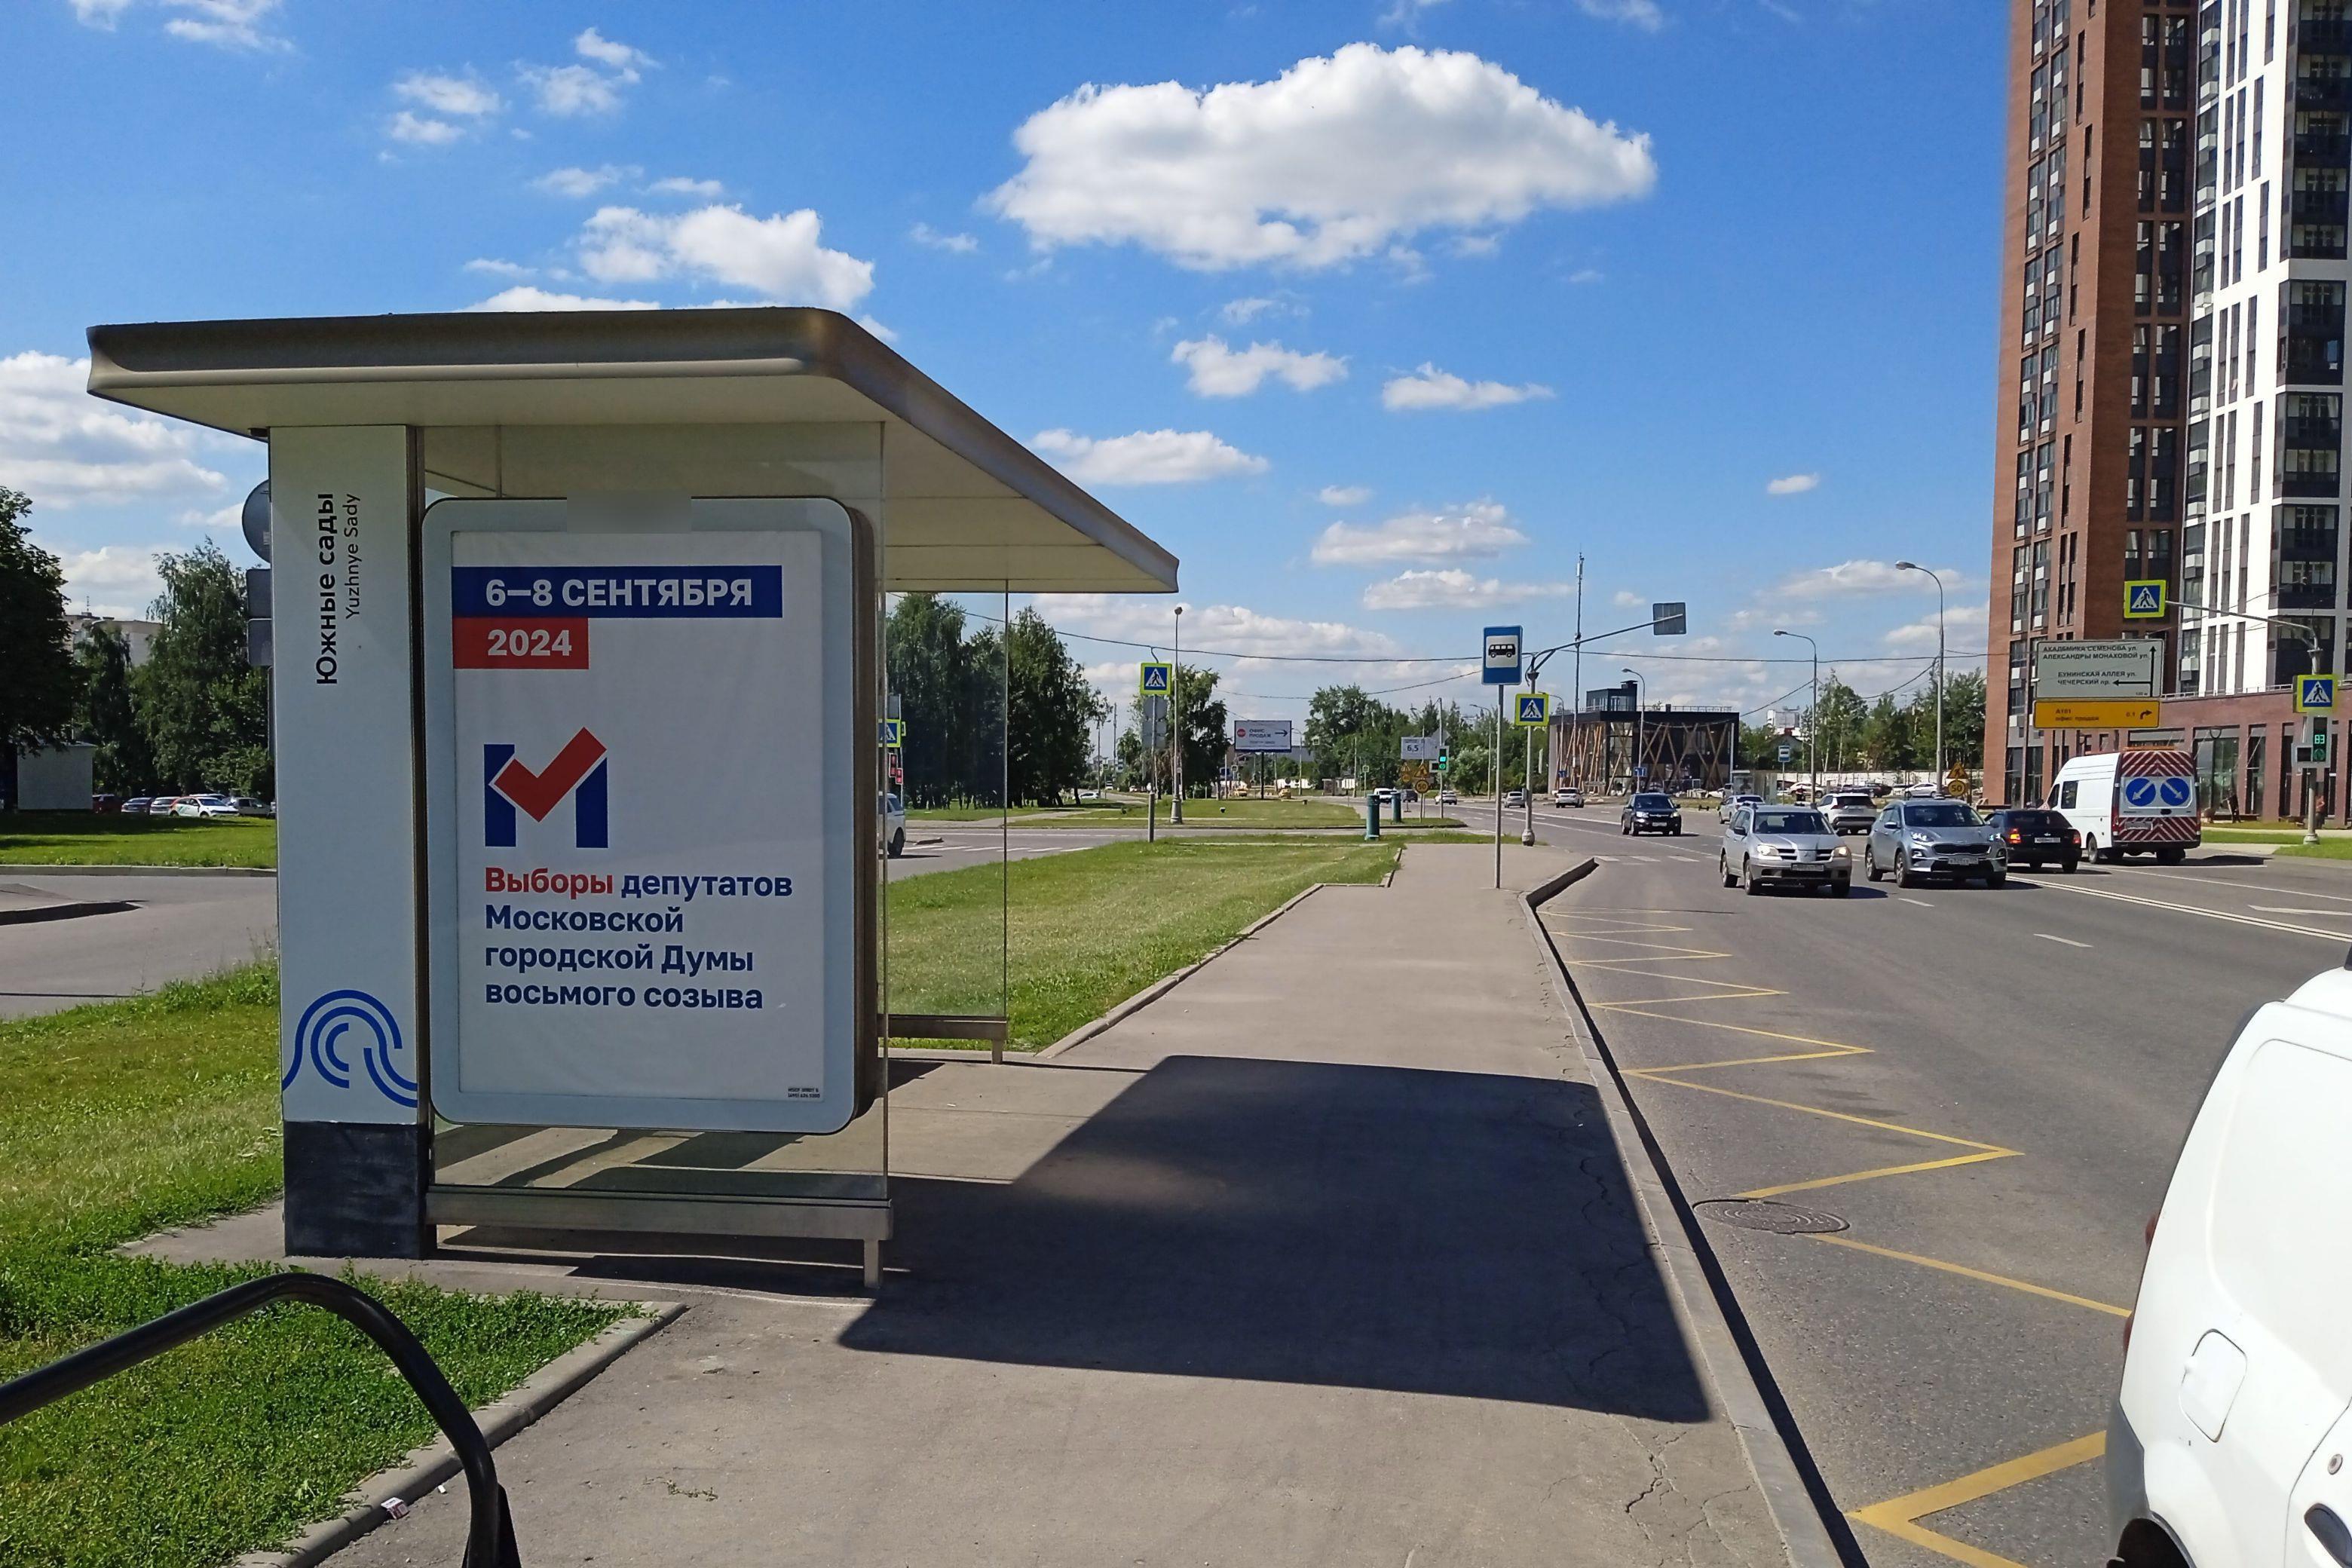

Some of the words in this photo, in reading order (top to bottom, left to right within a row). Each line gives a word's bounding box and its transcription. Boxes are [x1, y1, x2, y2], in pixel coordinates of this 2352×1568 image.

[317, 494, 338, 565] сады
[342, 494, 360, 537] Sady
[344, 543, 362, 620] Yuzhnye
[562, 579, 752, 607] СЕНТЯБРЯ
[316, 574, 338, 684] Южные
[487, 629, 572, 657] 2024
[2314, 734, 2325, 744] 83
[1951, 784, 1962, 792] 50
[485, 867, 613, 899] Выборы
[621, 874, 793, 902] депутатов
[485, 905, 684, 933] Московской
[485, 943, 654, 973] городской
[661, 945, 754, 977] Думы
[485, 983, 635, 1007] восьмого
[644, 987, 764, 1009] созыва
